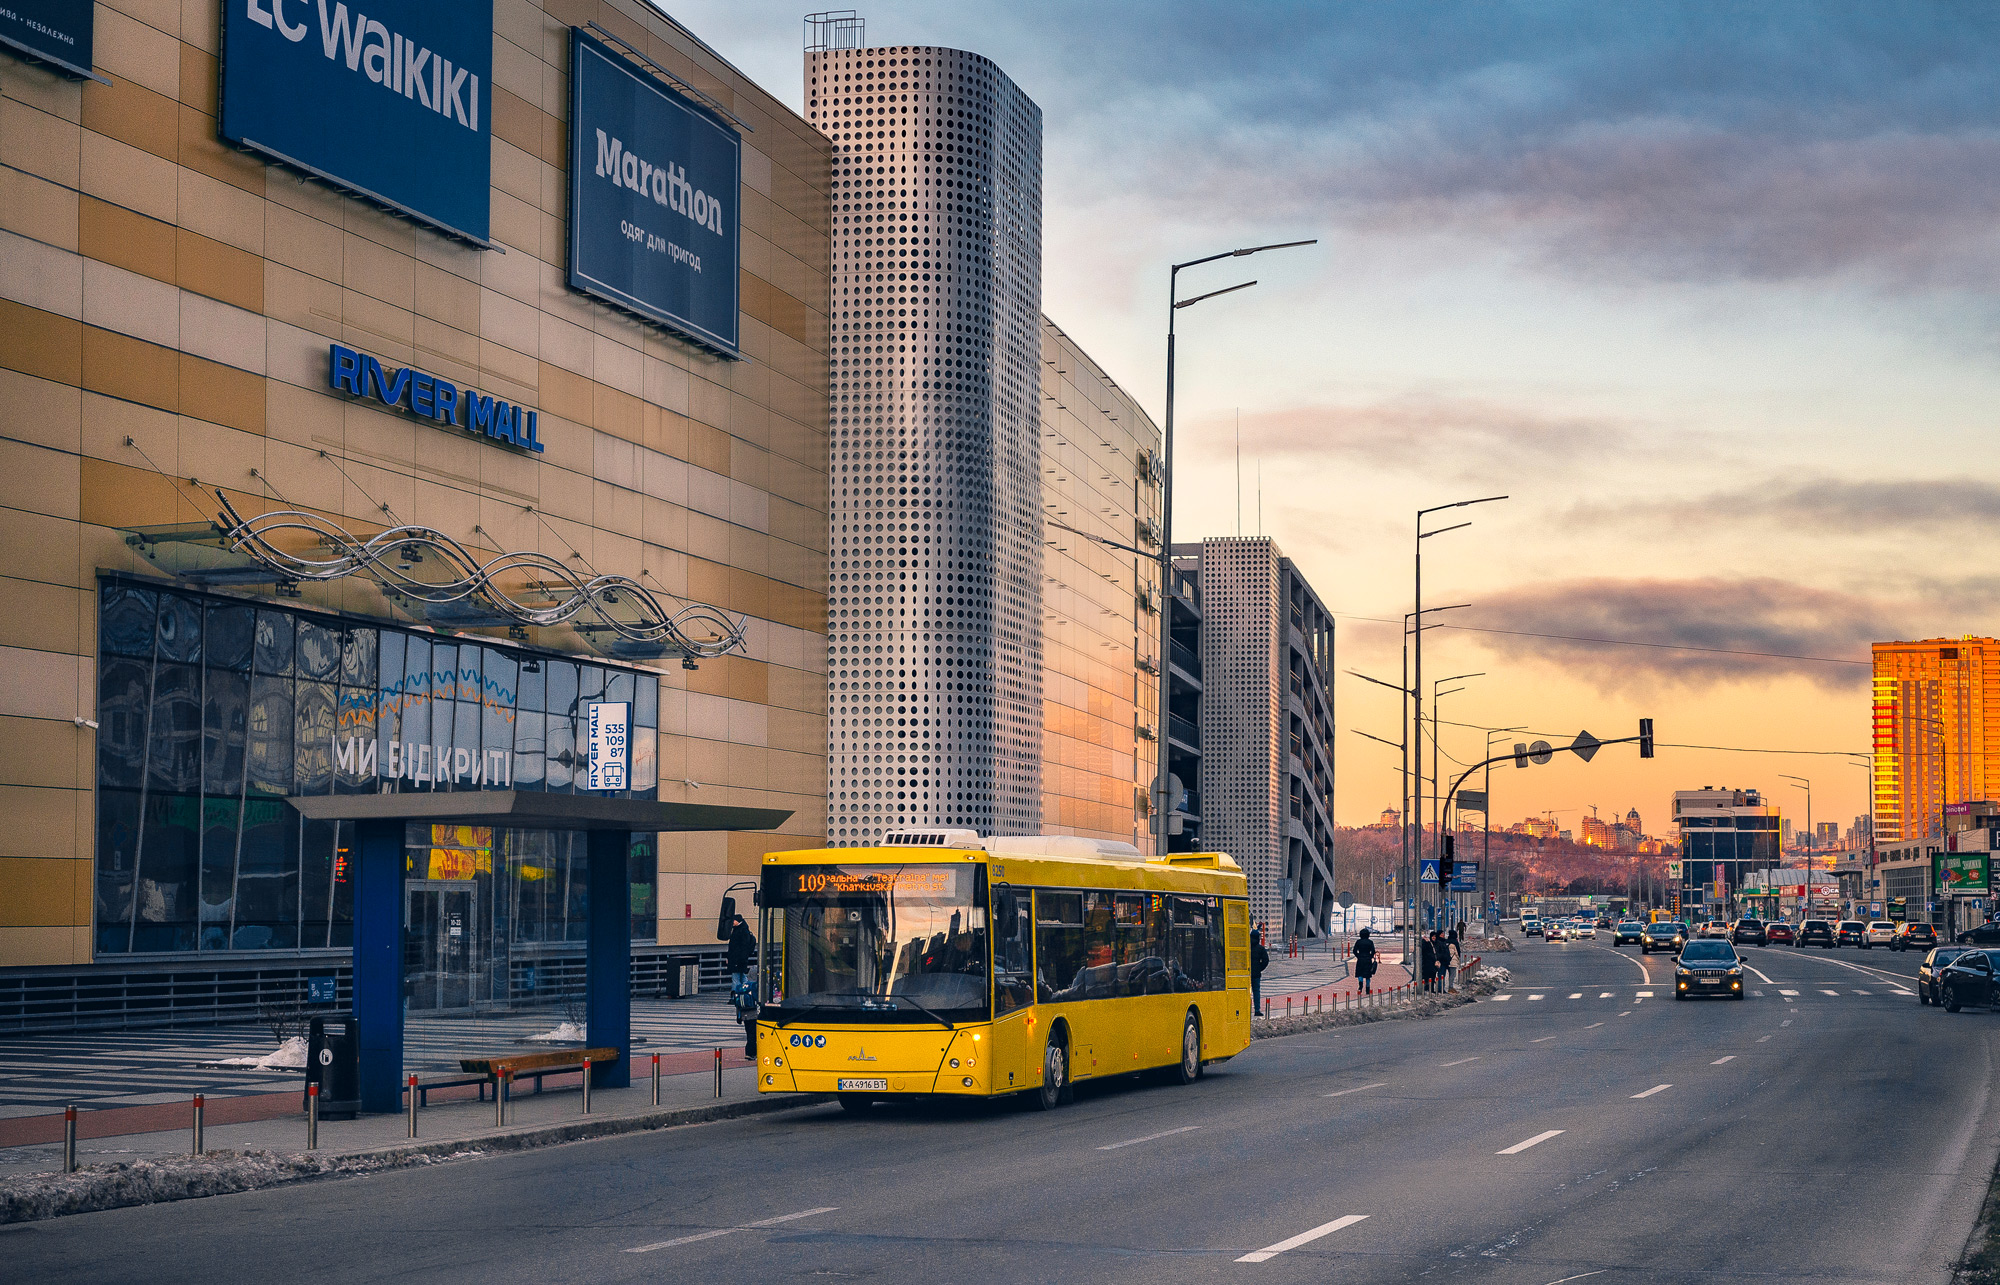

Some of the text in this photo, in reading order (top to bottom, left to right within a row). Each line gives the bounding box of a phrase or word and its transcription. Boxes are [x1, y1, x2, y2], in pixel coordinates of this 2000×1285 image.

[595, 127, 723, 237] Marathon
[620, 219, 702, 274] одяг для пригод
[329, 343, 544, 454] RIVER MALL
[605, 724, 625, 734] 535
[590, 705, 599, 787] RIVER MALL
[605, 735, 625, 746] 109
[331, 734, 510, 789] МИ ВІДКРИТІ
[610, 747, 625, 758] 87
[798, 874, 826, 892] 109
[898, 882, 930, 891] metro
[932, 882, 946, 891] st.
[842, 1080, 885, 1089] KA 4916 BT
